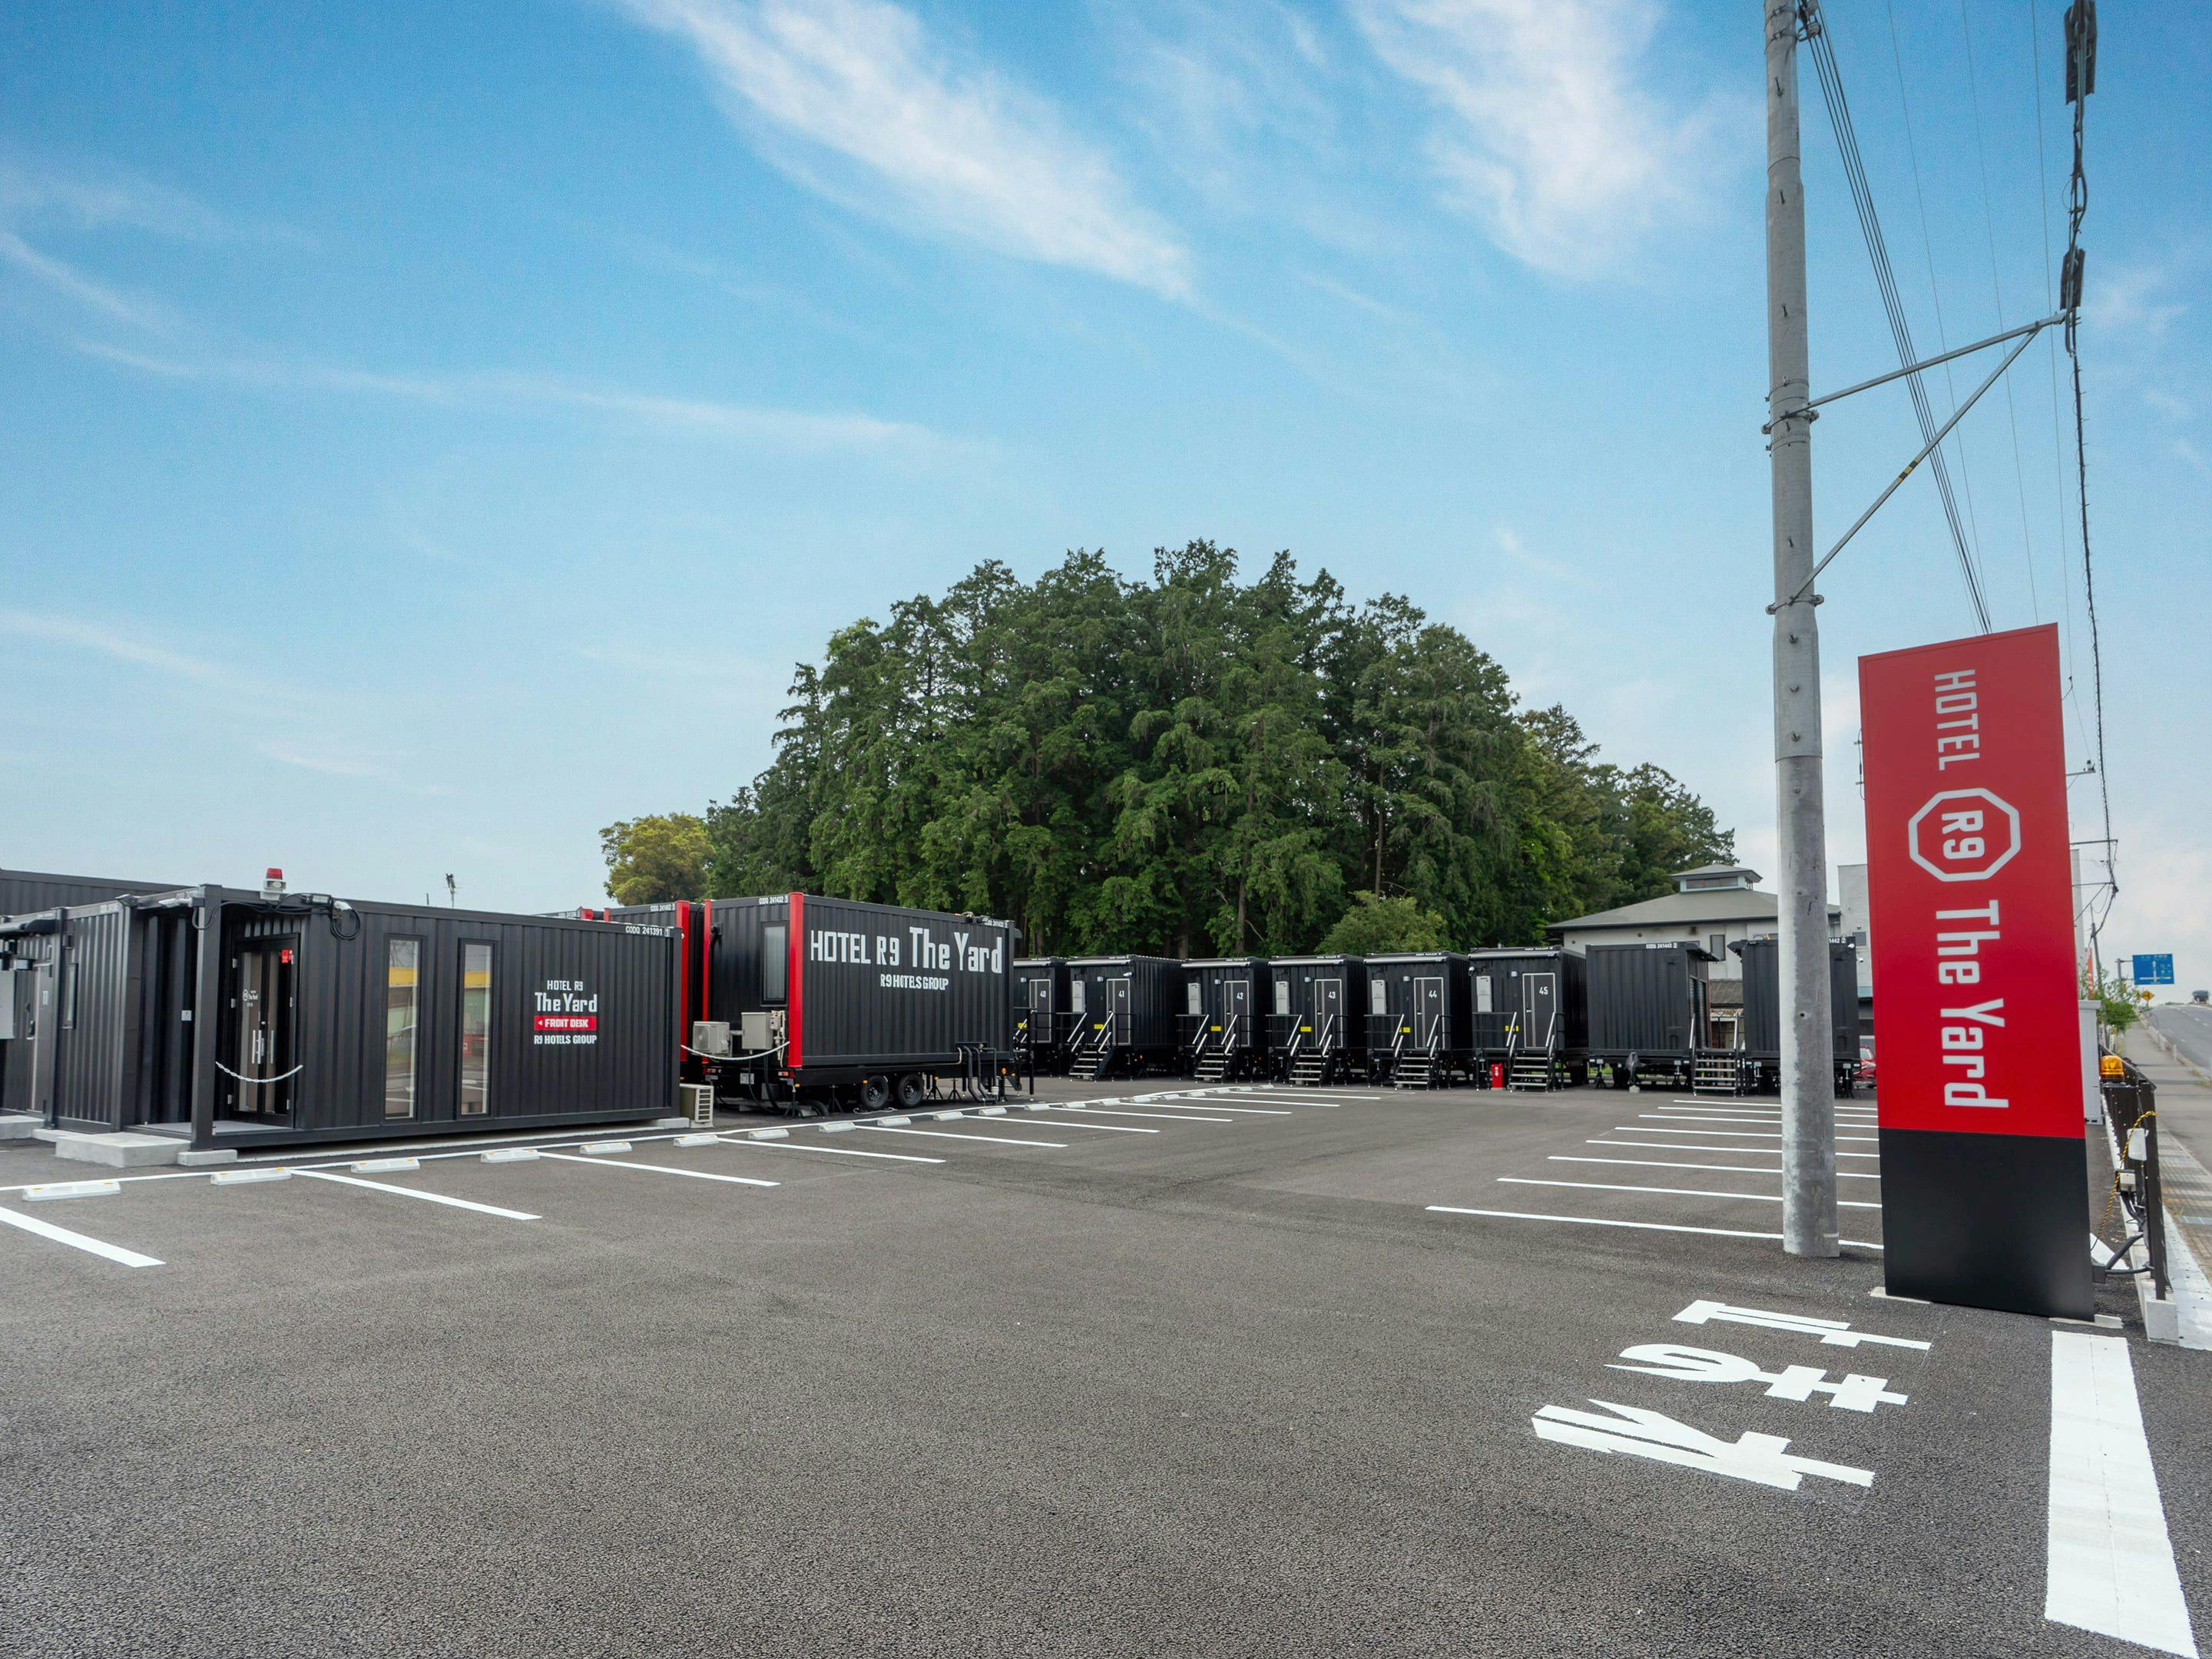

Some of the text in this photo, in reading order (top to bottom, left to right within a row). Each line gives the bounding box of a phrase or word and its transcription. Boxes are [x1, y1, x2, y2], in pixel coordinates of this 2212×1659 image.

[1935, 669, 2009, 1108] HOTEL R9 The Yard
[811, 926, 1002, 974] HOTEL R9 The Yard
[547, 980, 584, 991] HOTEL R9
[880, 974, 949, 991] R9 HOTELS GROUP
[1328, 991, 1336, 999] 43
[1429, 990, 1437, 998] 44
[1538, 986, 1548, 995] 45
[1236, 992, 1244, 1000] 42
[535, 992, 598, 1012] The Yard
[545, 1018, 588, 1028] FRONT DESK
[534, 1035, 598, 1045] R9 HOTELS GROUP
[1531, 1300, 1932, 1491] 止まれ
